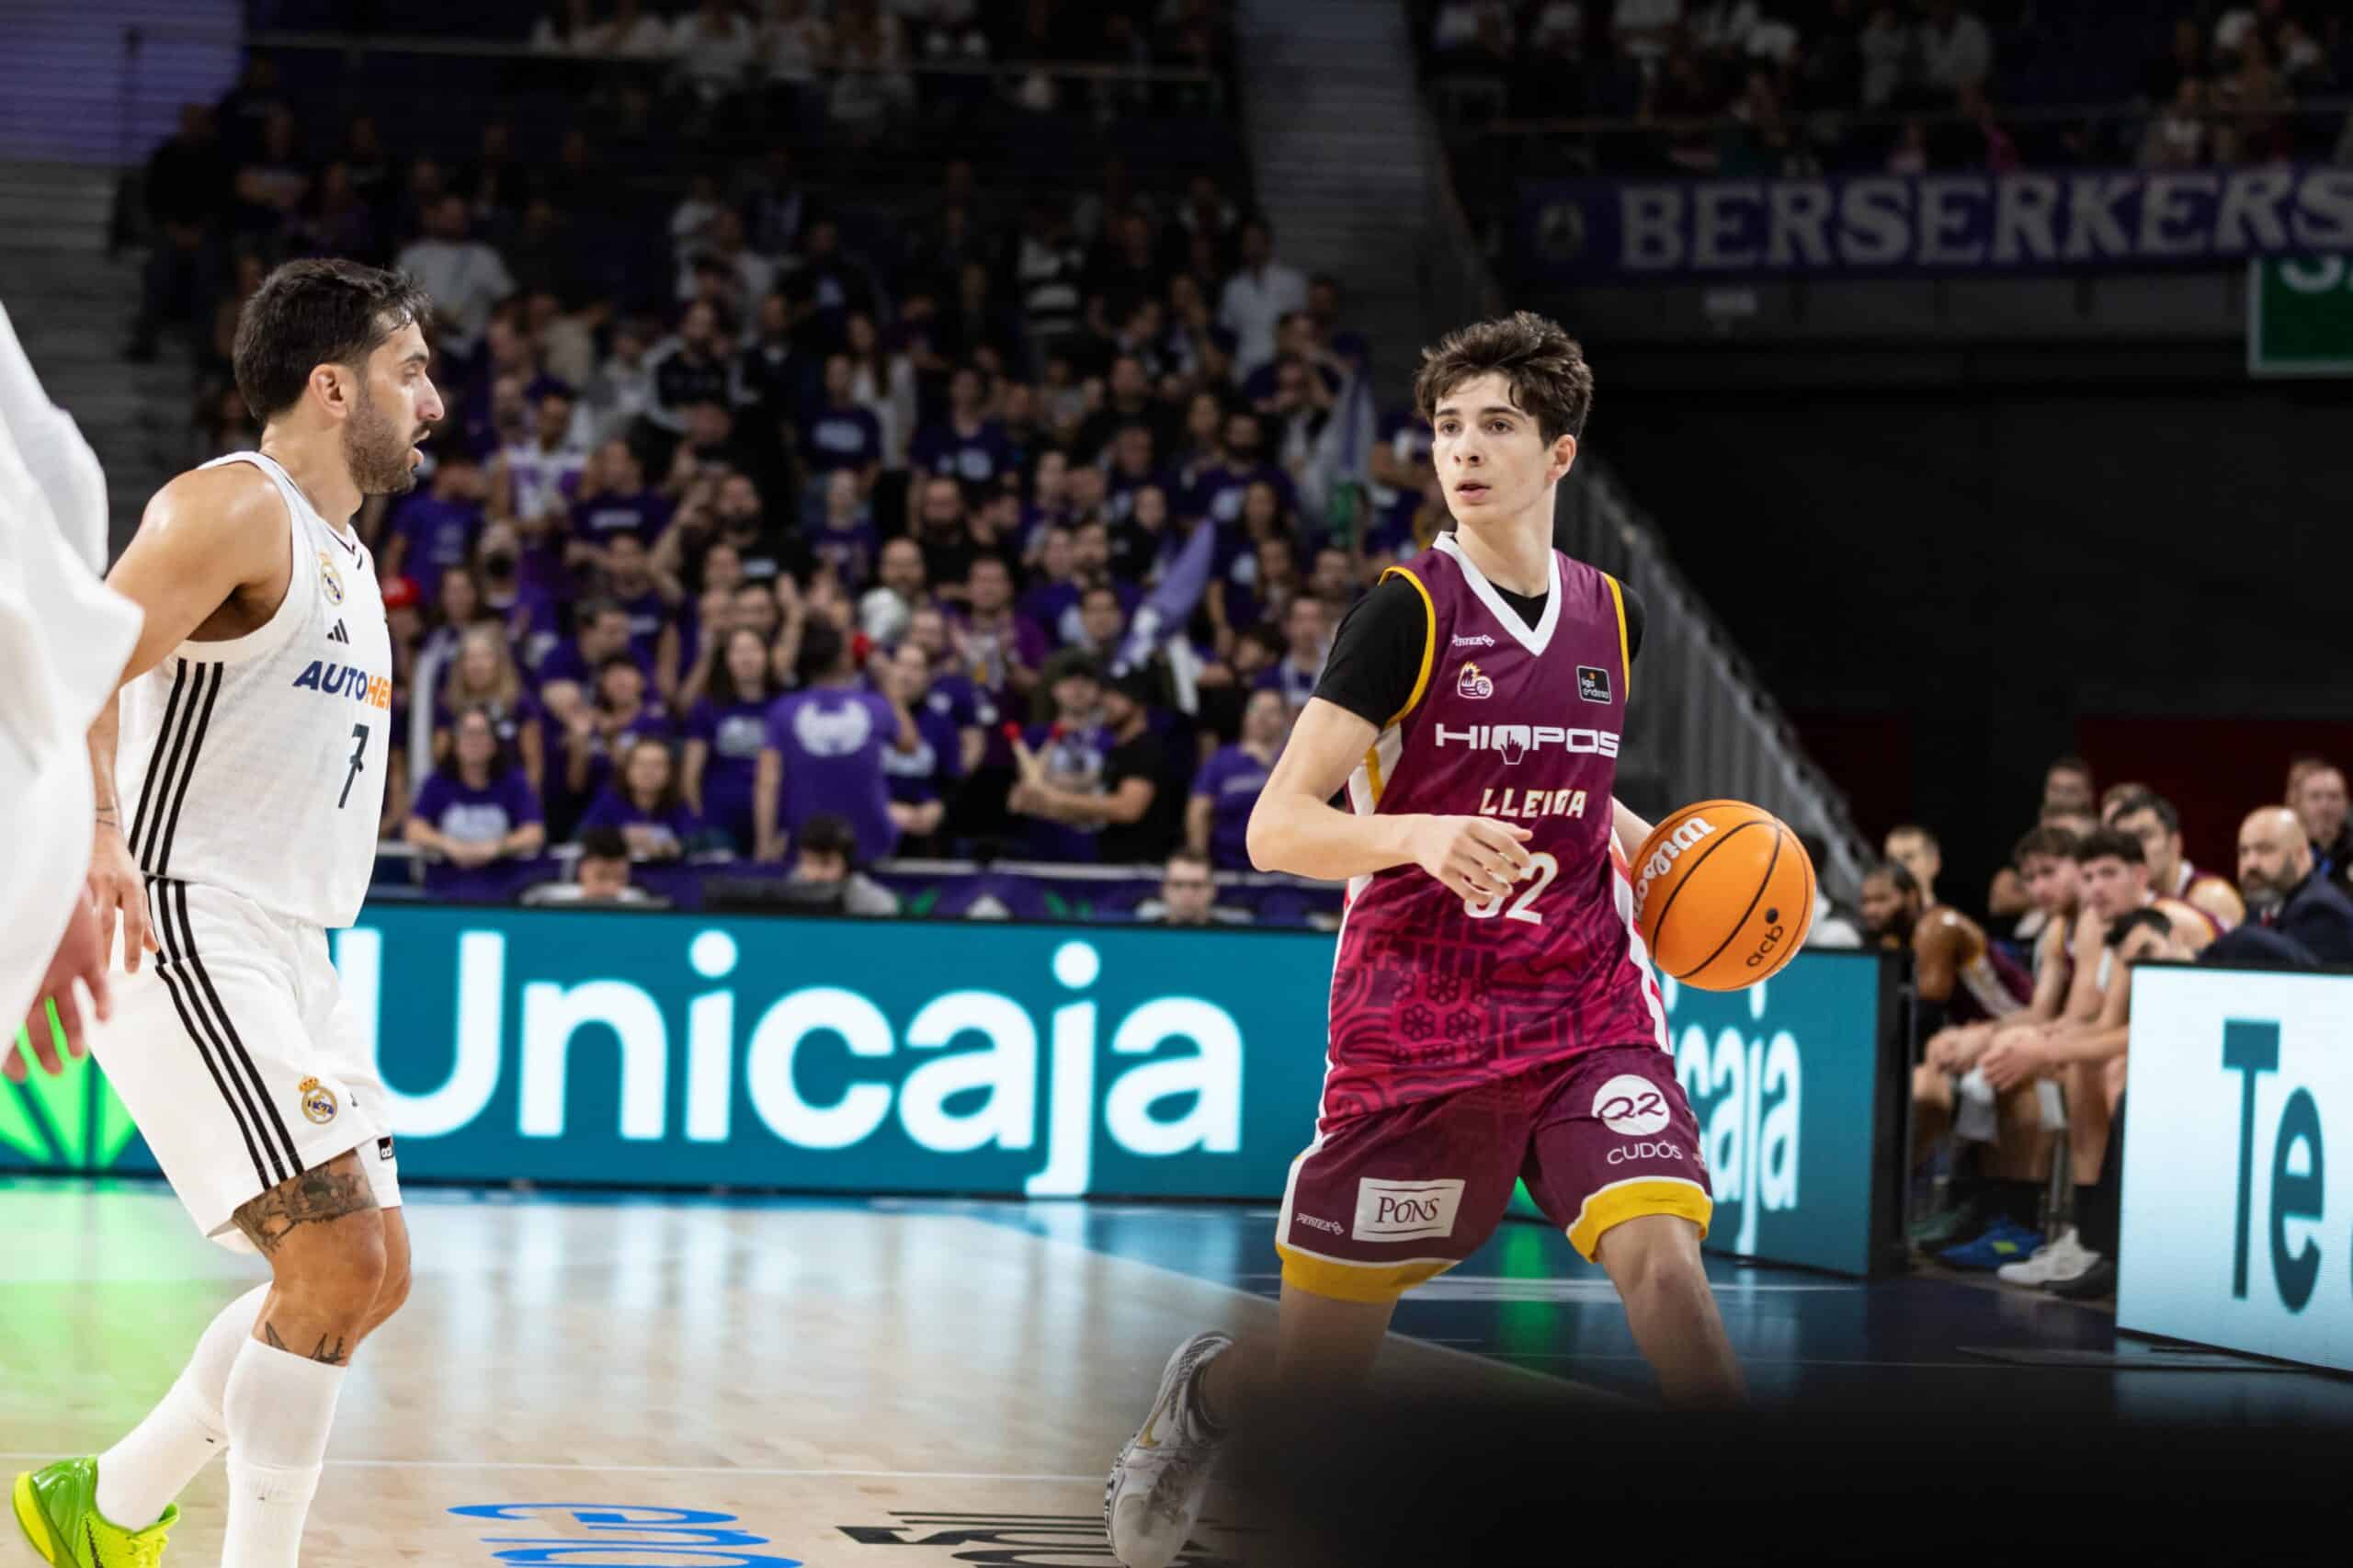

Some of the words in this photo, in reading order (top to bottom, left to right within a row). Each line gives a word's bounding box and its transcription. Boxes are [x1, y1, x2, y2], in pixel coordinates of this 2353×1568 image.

[1620, 164, 2353, 270] BERSERKERS
[337, 723, 369, 809] 7
[1745, 926, 1784, 968] acb
[335, 928, 1244, 1198] Unicaja
[1662, 976, 1802, 1256] caja
[1375, 1197, 1440, 1224] PONS
[2222, 1018, 2325, 1314] Te
